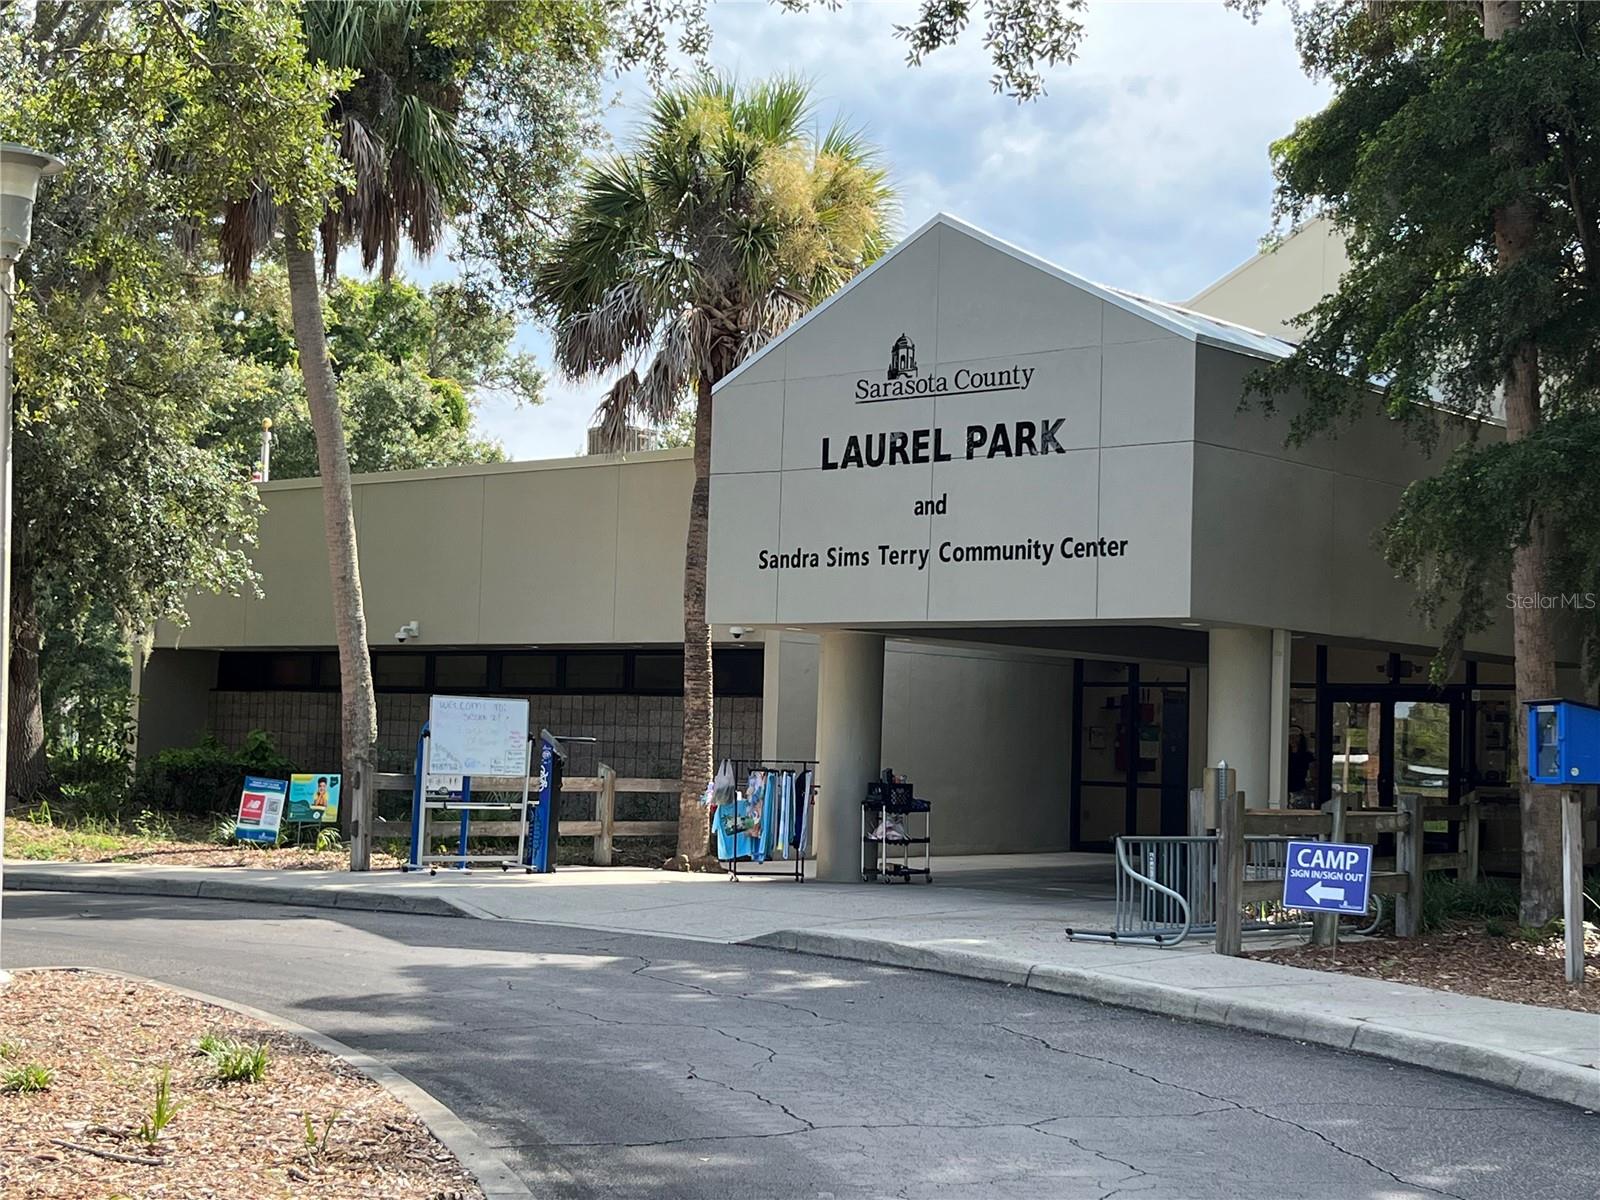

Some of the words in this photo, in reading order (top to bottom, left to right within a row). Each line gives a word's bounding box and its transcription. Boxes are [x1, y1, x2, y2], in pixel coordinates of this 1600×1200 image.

[855, 373, 949, 400] Sarasota
[954, 365, 1035, 390] County
[821, 428, 951, 471] LAUREL
[966, 418, 1066, 460] PARK
[914, 493, 947, 516] and
[758, 547, 819, 570] Sandra
[826, 546, 870, 568] Sims
[878, 545, 930, 570] Terry
[939, 538, 1054, 566] Community
[1060, 537, 1129, 559] Center
[1297, 848, 1359, 871] CAMP
[1290, 868, 1310, 879] SIGN
[1311, 870, 1343, 881] IN/SIGN
[1344, 873, 1364, 882] OUT
